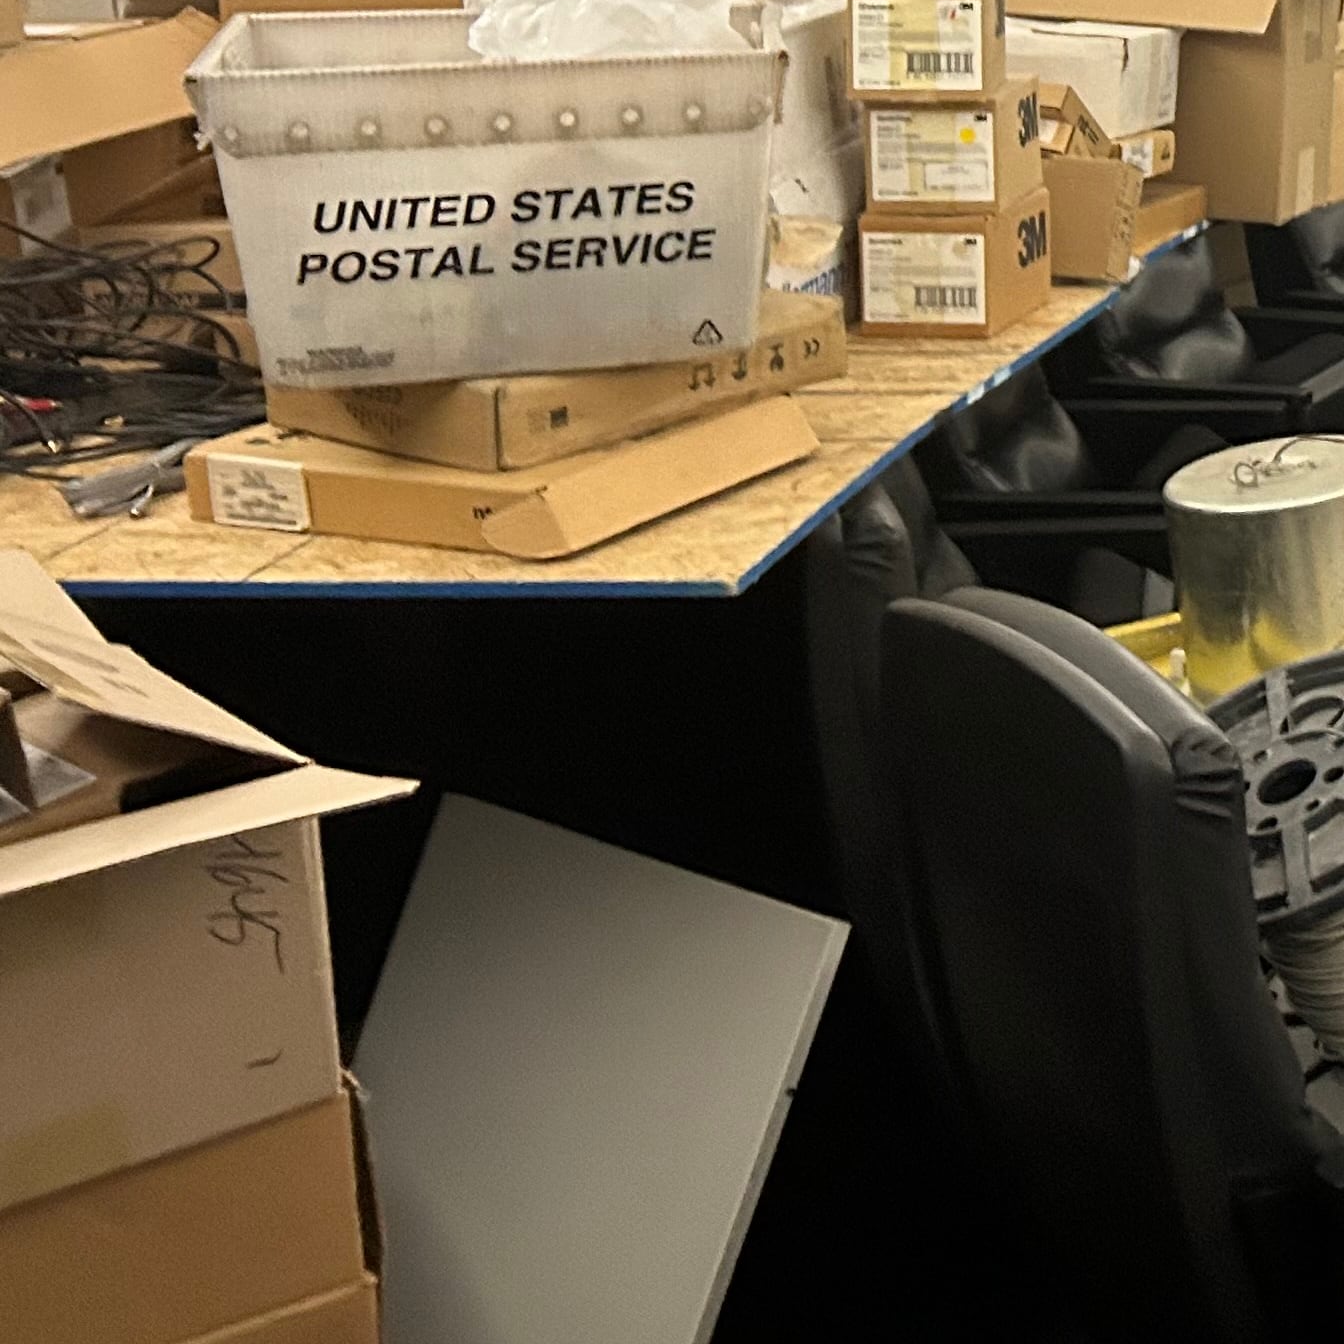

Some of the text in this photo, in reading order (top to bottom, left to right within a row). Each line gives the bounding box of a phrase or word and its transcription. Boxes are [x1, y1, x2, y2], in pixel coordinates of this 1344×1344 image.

[1017, 91, 1039, 148] 3M
[313, 181, 695, 233] UNITED STATES
[296, 228, 717, 286] POSTAL SERVICE
[1017, 210, 1047, 269] 3M
